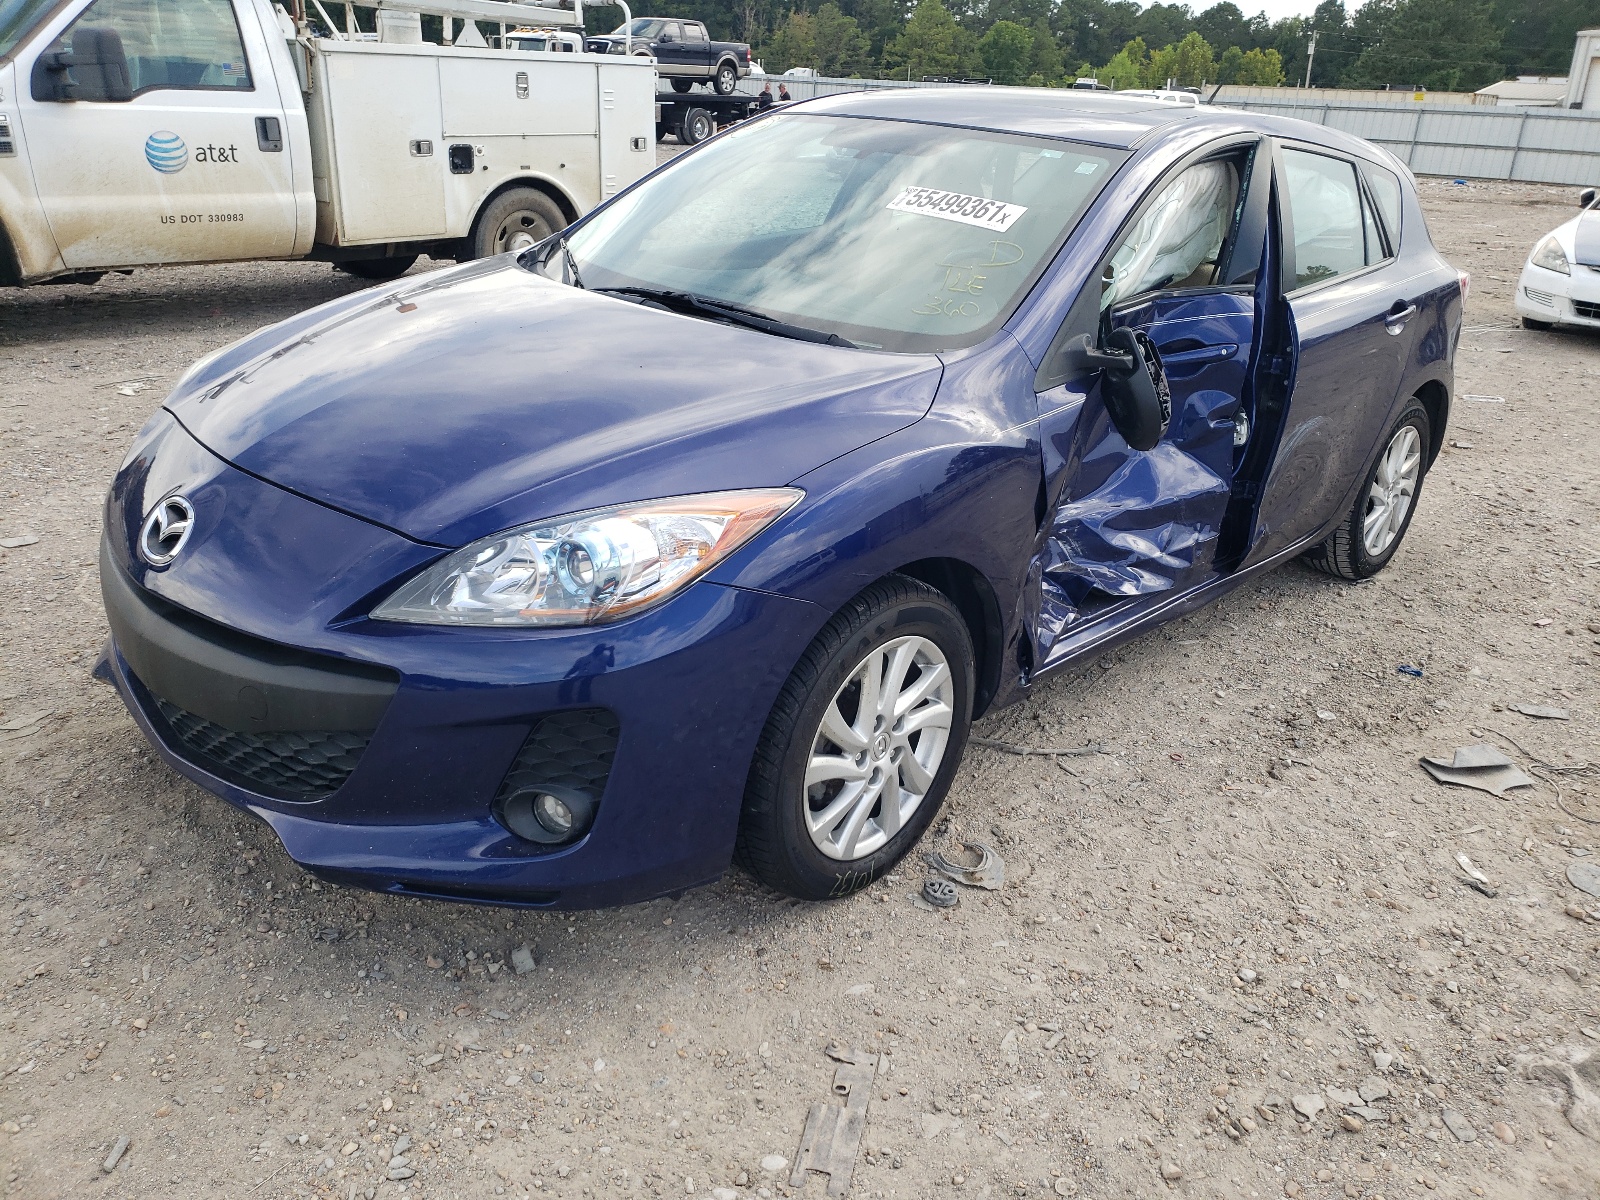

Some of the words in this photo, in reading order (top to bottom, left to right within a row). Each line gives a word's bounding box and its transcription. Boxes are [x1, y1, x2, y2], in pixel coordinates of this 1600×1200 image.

[195, 144, 238, 163] at&t
[160, 215, 176, 224] US
[180, 214, 203, 223] DOT
[208, 213, 244, 222] 330983
